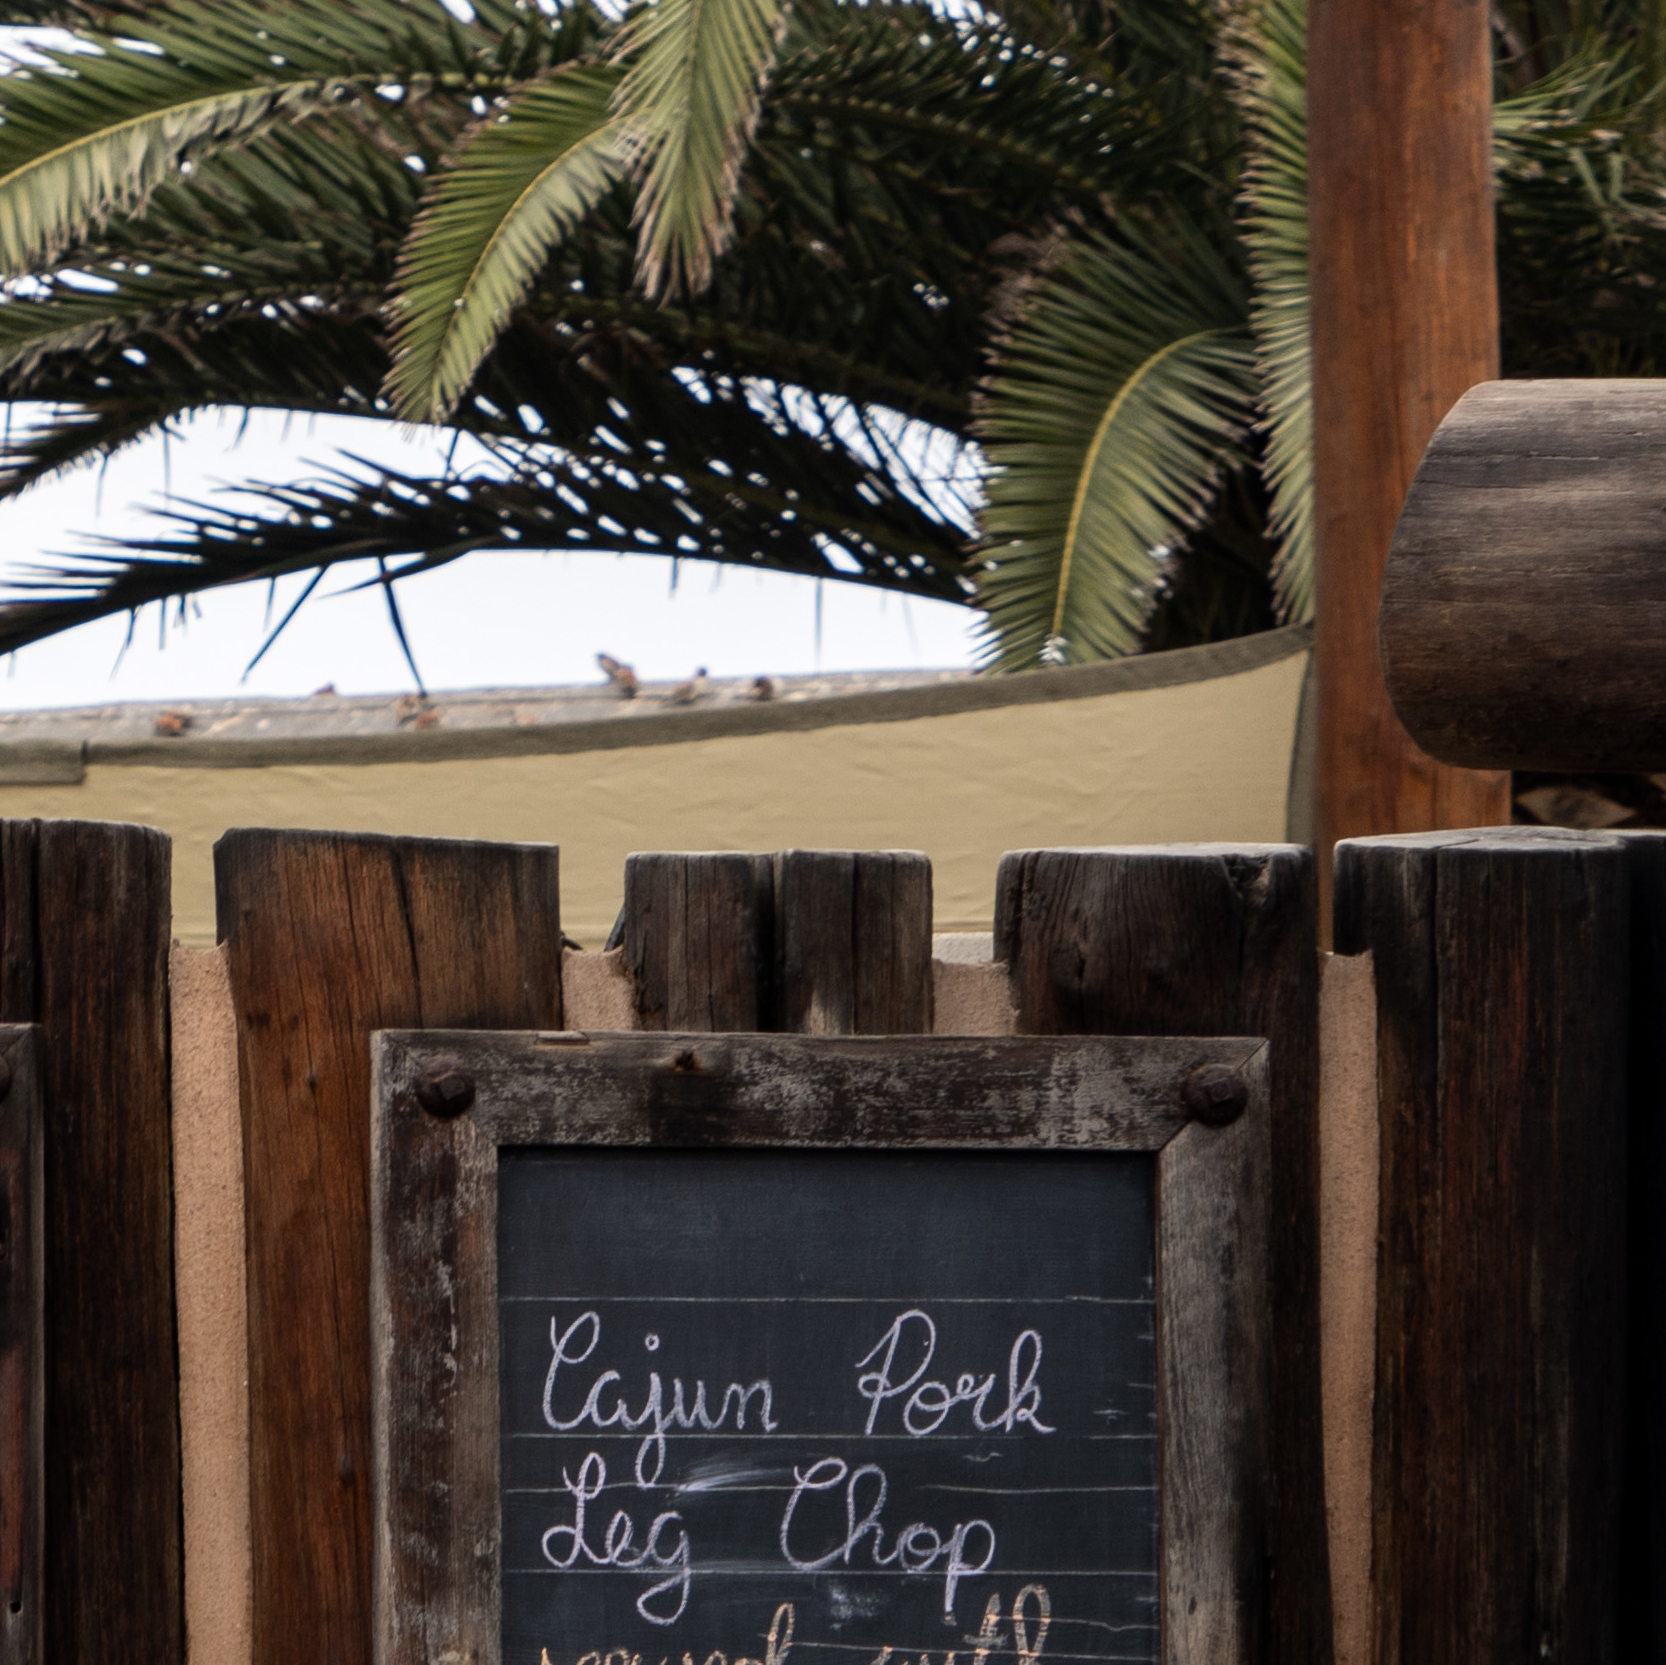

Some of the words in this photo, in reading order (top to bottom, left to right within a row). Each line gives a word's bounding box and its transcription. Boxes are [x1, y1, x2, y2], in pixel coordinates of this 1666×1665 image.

[542, 1311, 778, 1488] Cajun
[855, 1309, 1056, 1436] Pork
[542, 1452, 691, 1625] Leg
[780, 1457, 996, 1622] Chop
